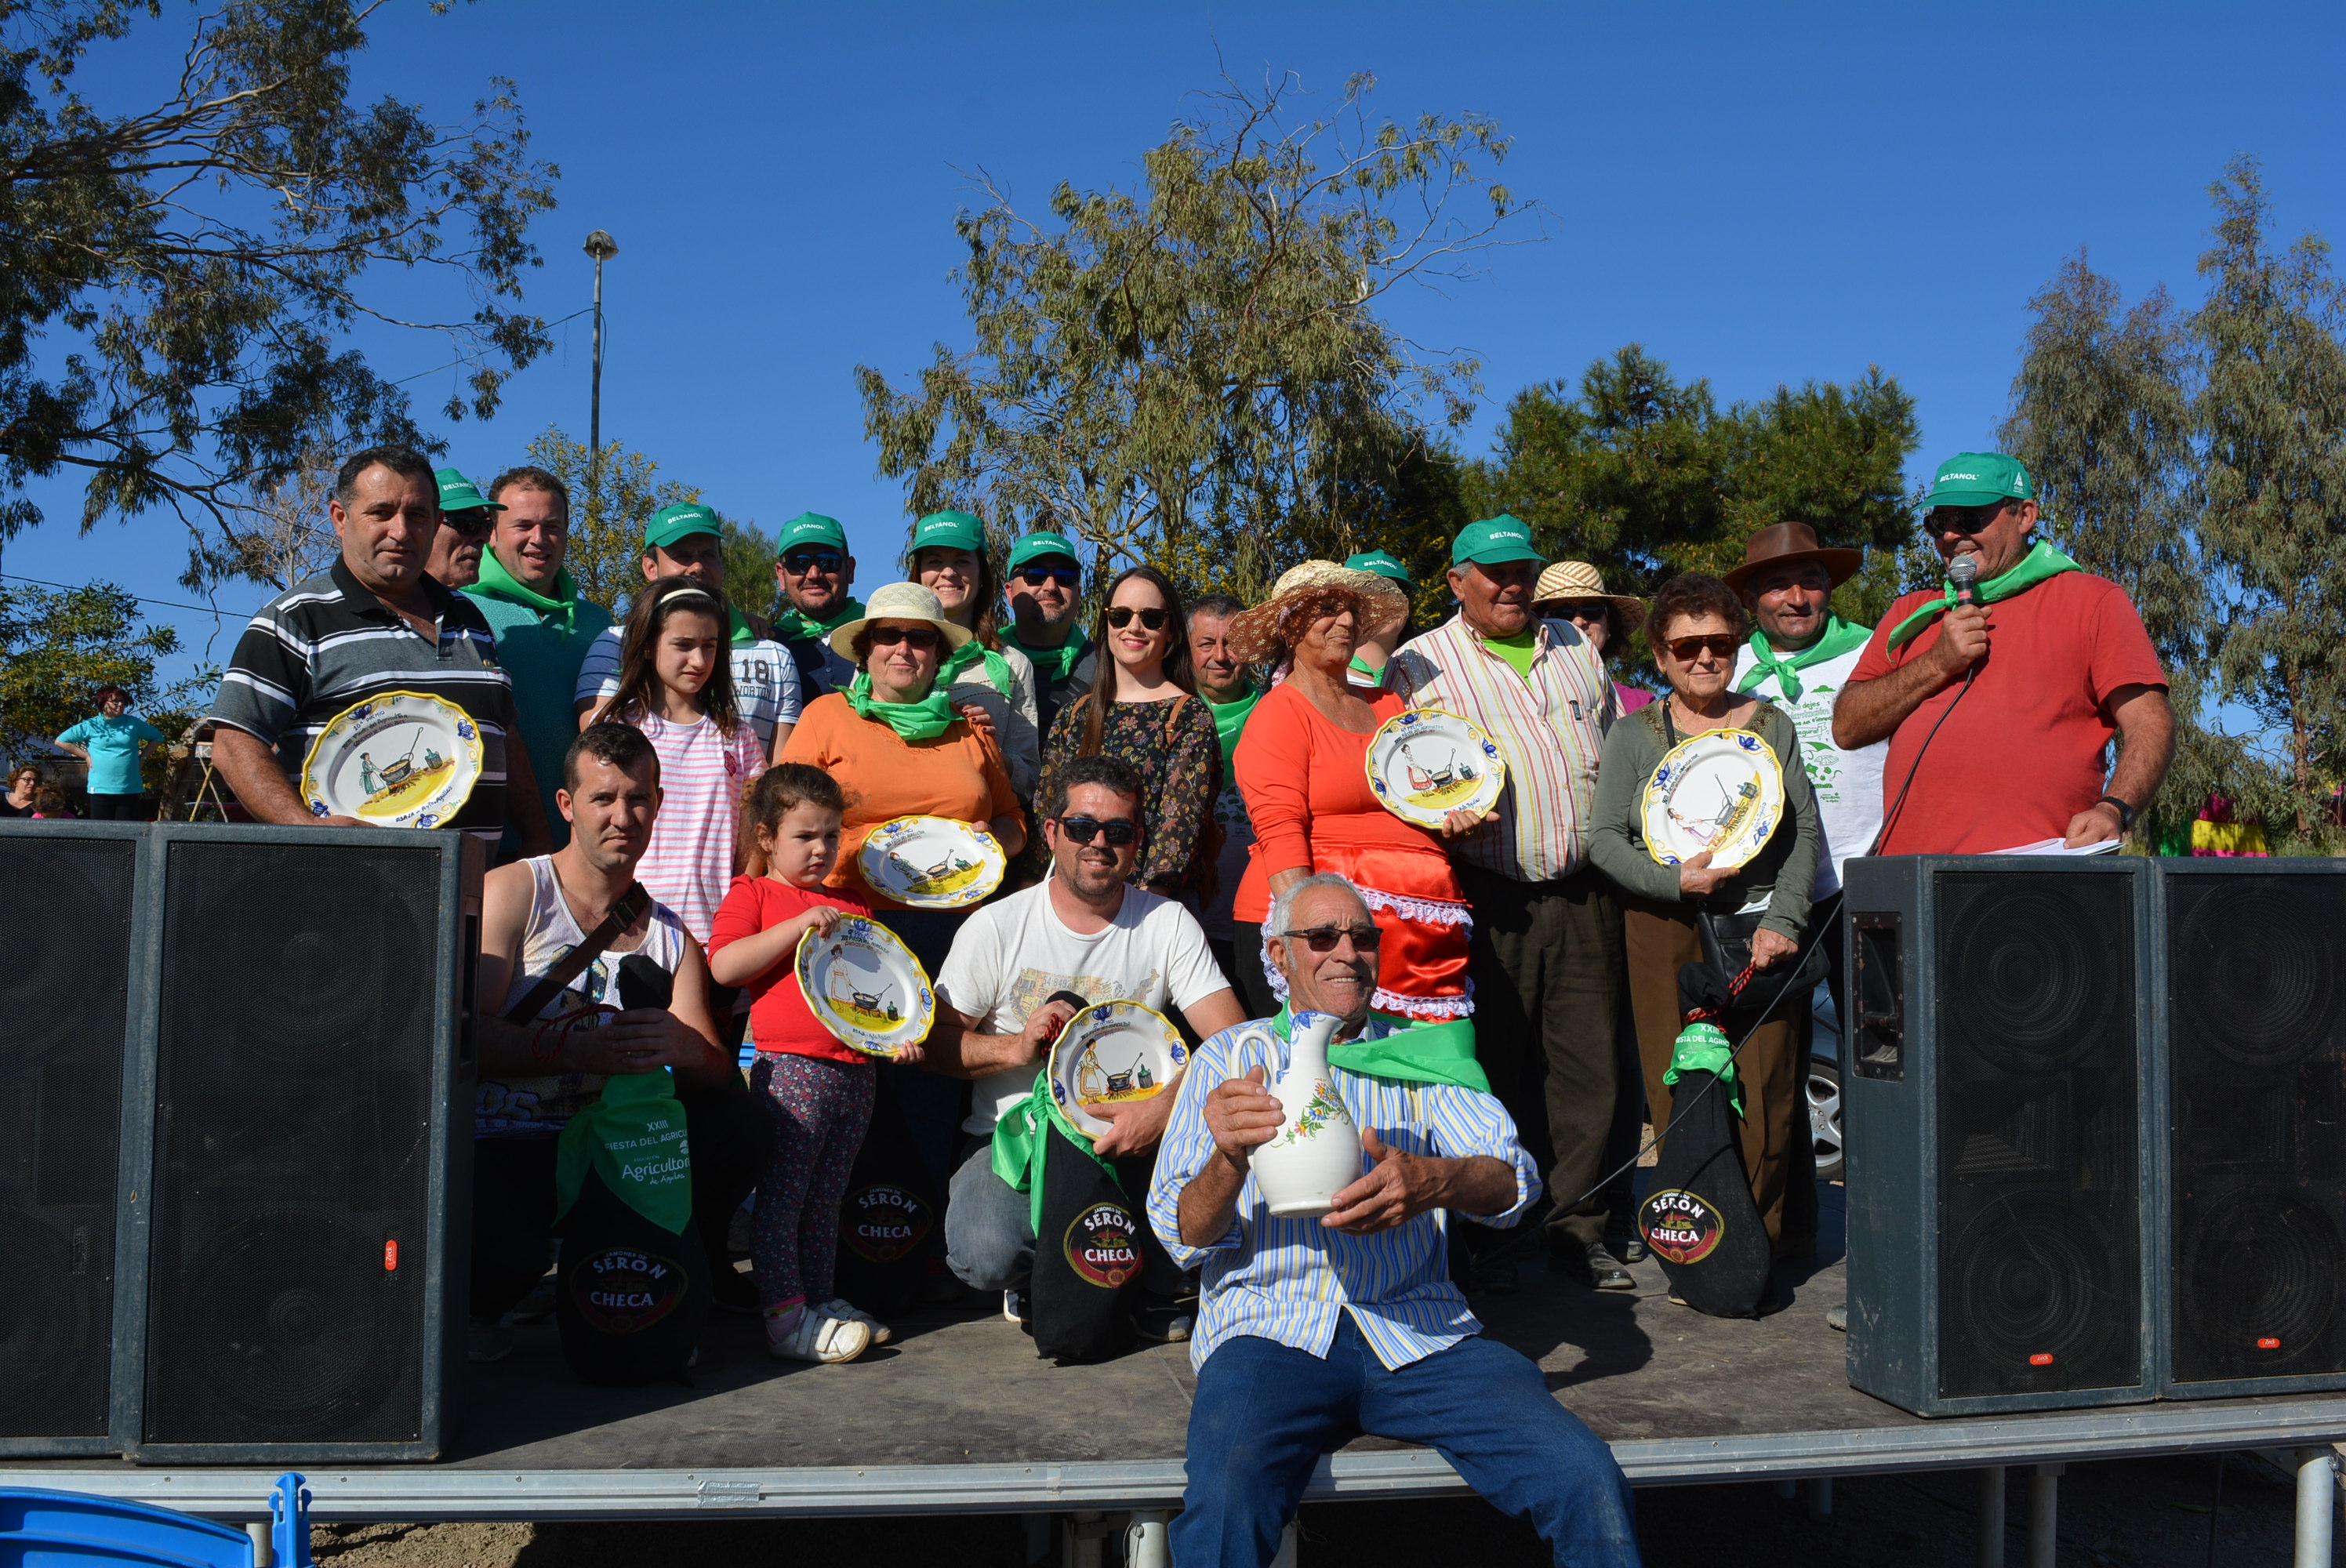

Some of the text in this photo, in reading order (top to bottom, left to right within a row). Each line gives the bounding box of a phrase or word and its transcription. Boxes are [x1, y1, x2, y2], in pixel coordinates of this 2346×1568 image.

[667, 512, 703, 524] BELTANOL
[793, 523, 826, 534] BELTANOL
[924, 521, 960, 532] BELTANOL
[741, 659, 769, 685] 18
[1700, 1024, 1720, 1035] XXIII
[647, 1120, 669, 1132] XXIII
[605, 1140, 637, 1150] FIESTA
[639, 1136, 658, 1146] DEL
[857, 1225, 912, 1238] CHECA
[1651, 1227, 1700, 1243] CHECA
[1084, 1248, 1135, 1262] CHECA
[590, 1291, 655, 1307] CHECA
